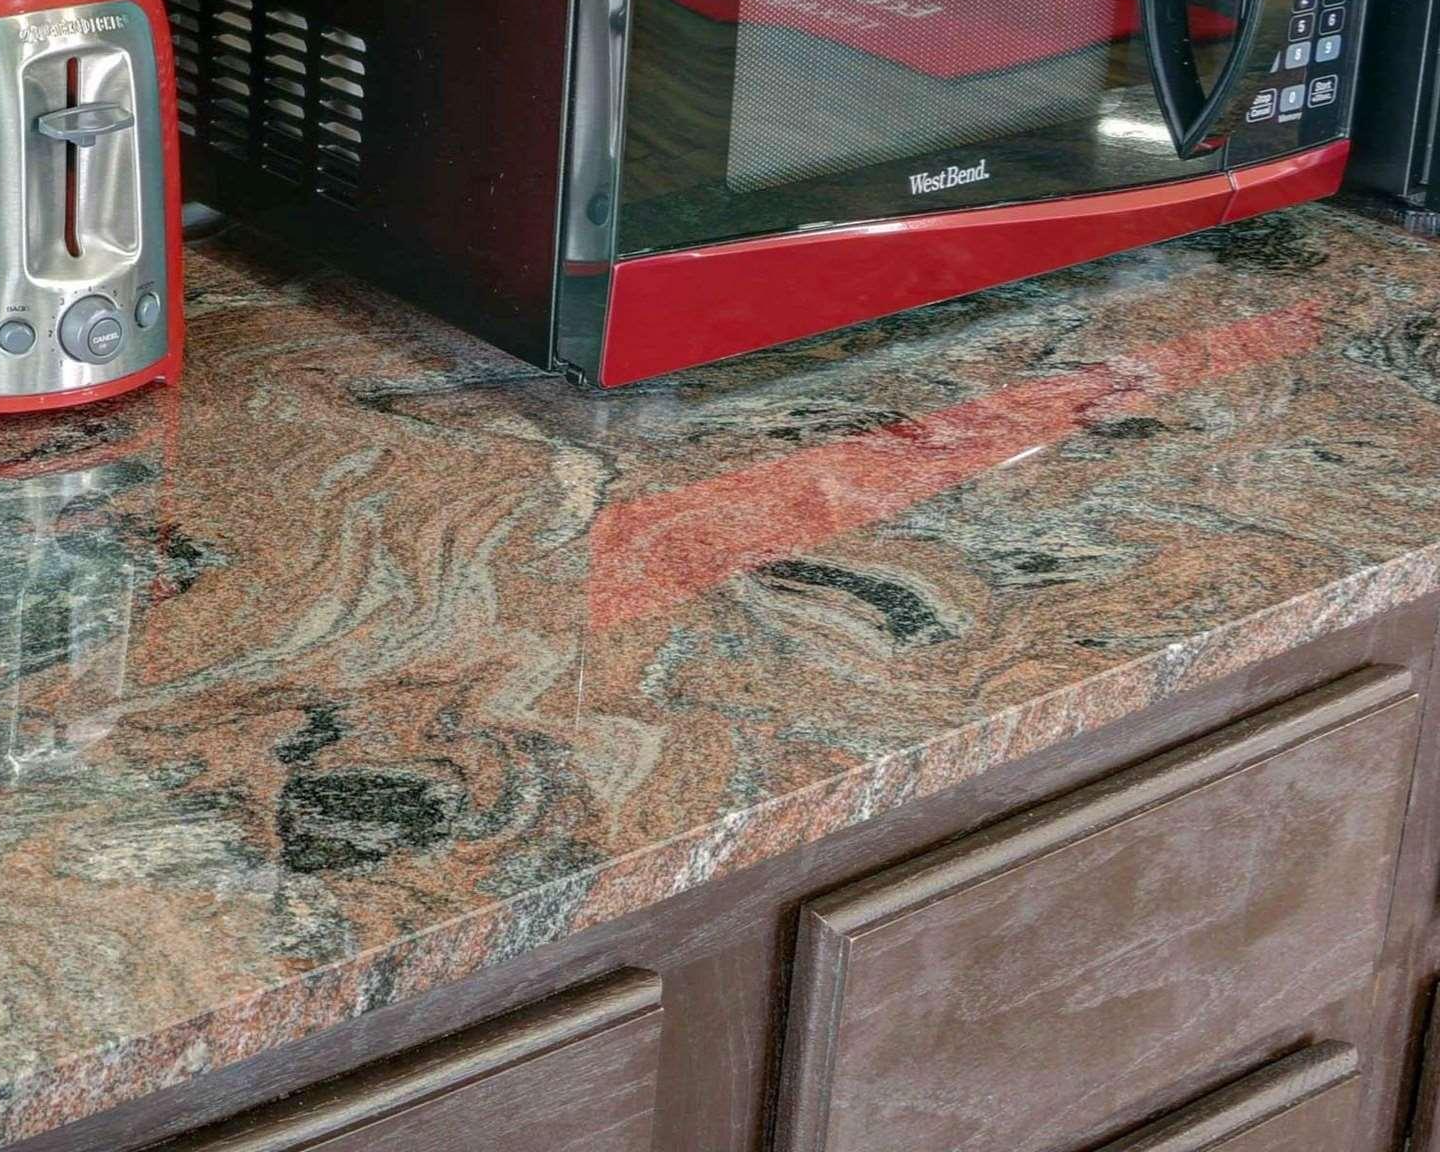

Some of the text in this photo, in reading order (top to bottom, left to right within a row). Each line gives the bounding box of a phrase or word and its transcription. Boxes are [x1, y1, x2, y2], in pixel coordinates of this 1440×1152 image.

[1328, 13, 1337, 26] 6
[1297, 20, 1306, 33] 5
[1324, 41, 1332, 54] 9
[1294, 48, 1302, 61] 8
[1288, 91, 1296, 104] 0
[92, 331, 120, 345] CANCEL
